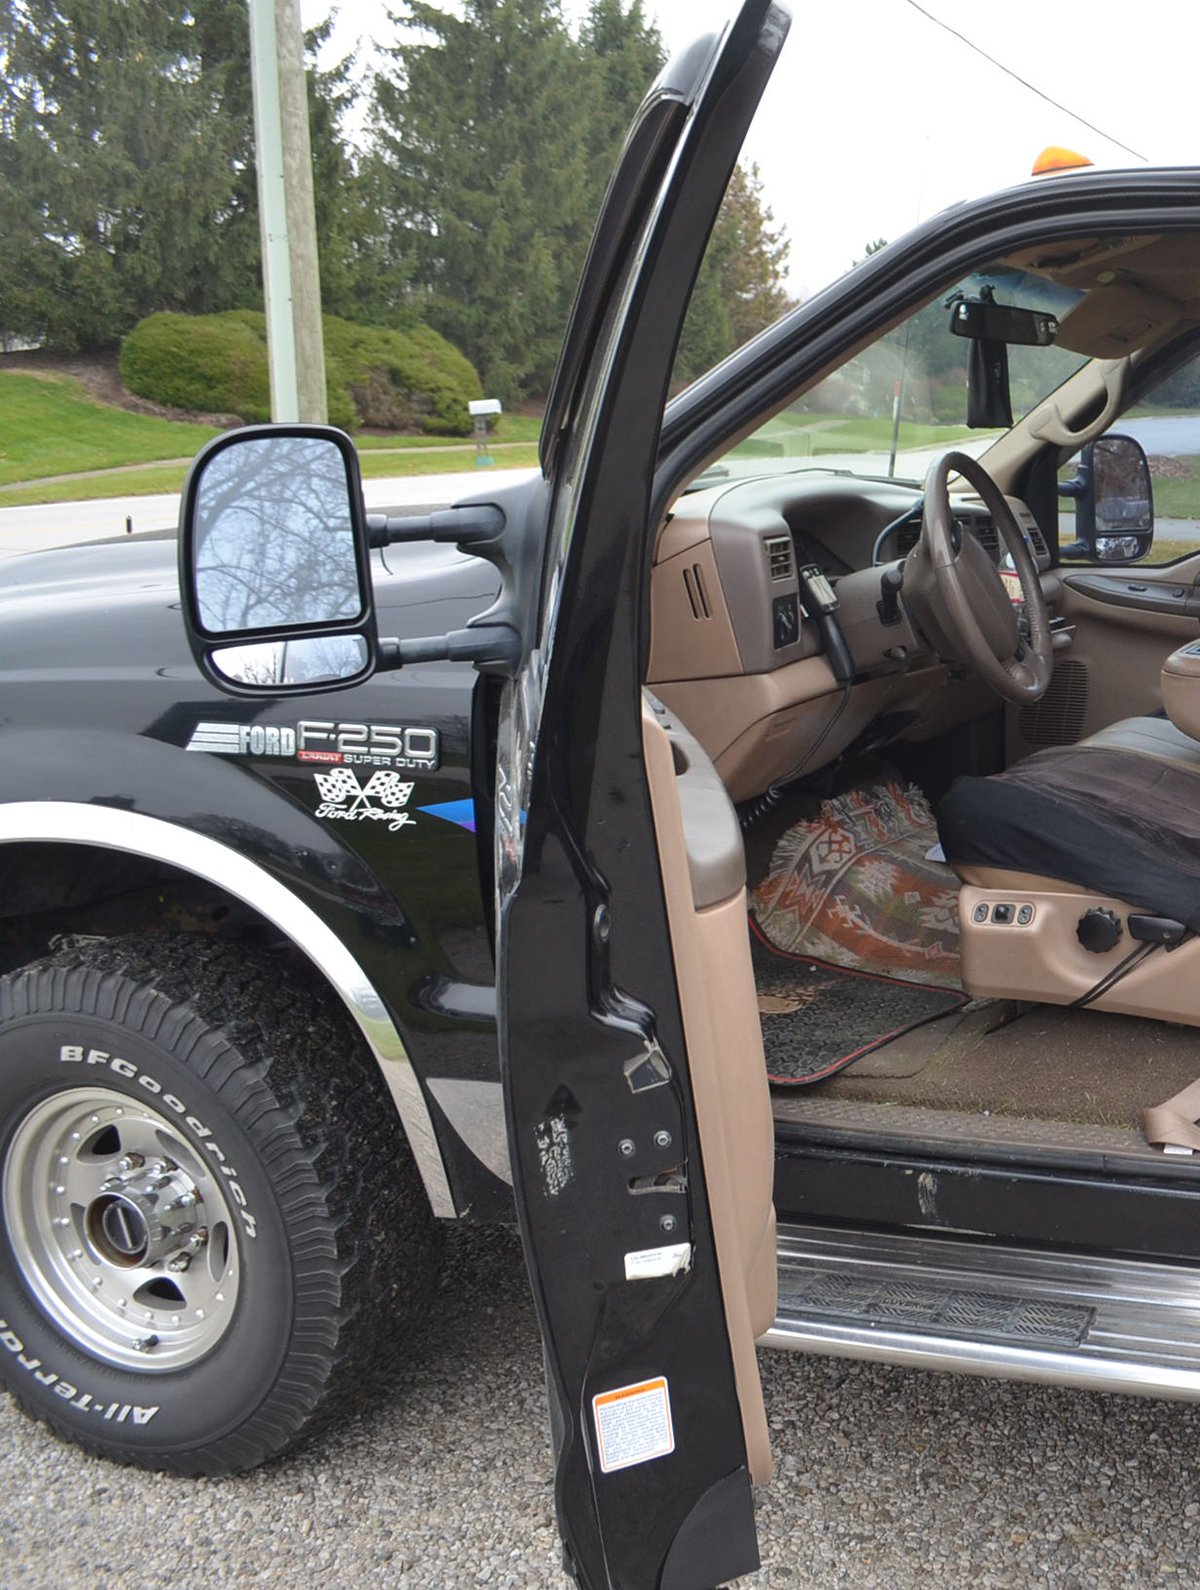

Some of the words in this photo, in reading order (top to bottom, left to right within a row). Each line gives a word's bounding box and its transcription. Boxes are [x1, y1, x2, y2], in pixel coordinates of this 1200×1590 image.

[239, 725, 296, 757] FORD
[297, 720, 437, 759] F-250
[343, 754, 392, 766] SUPER
[396, 758, 436, 770] DUTY
[315, 802, 358, 821] Ford
[359, 807, 417, 832] Racing
[60, 1045, 257, 1239] BFGoodrich
